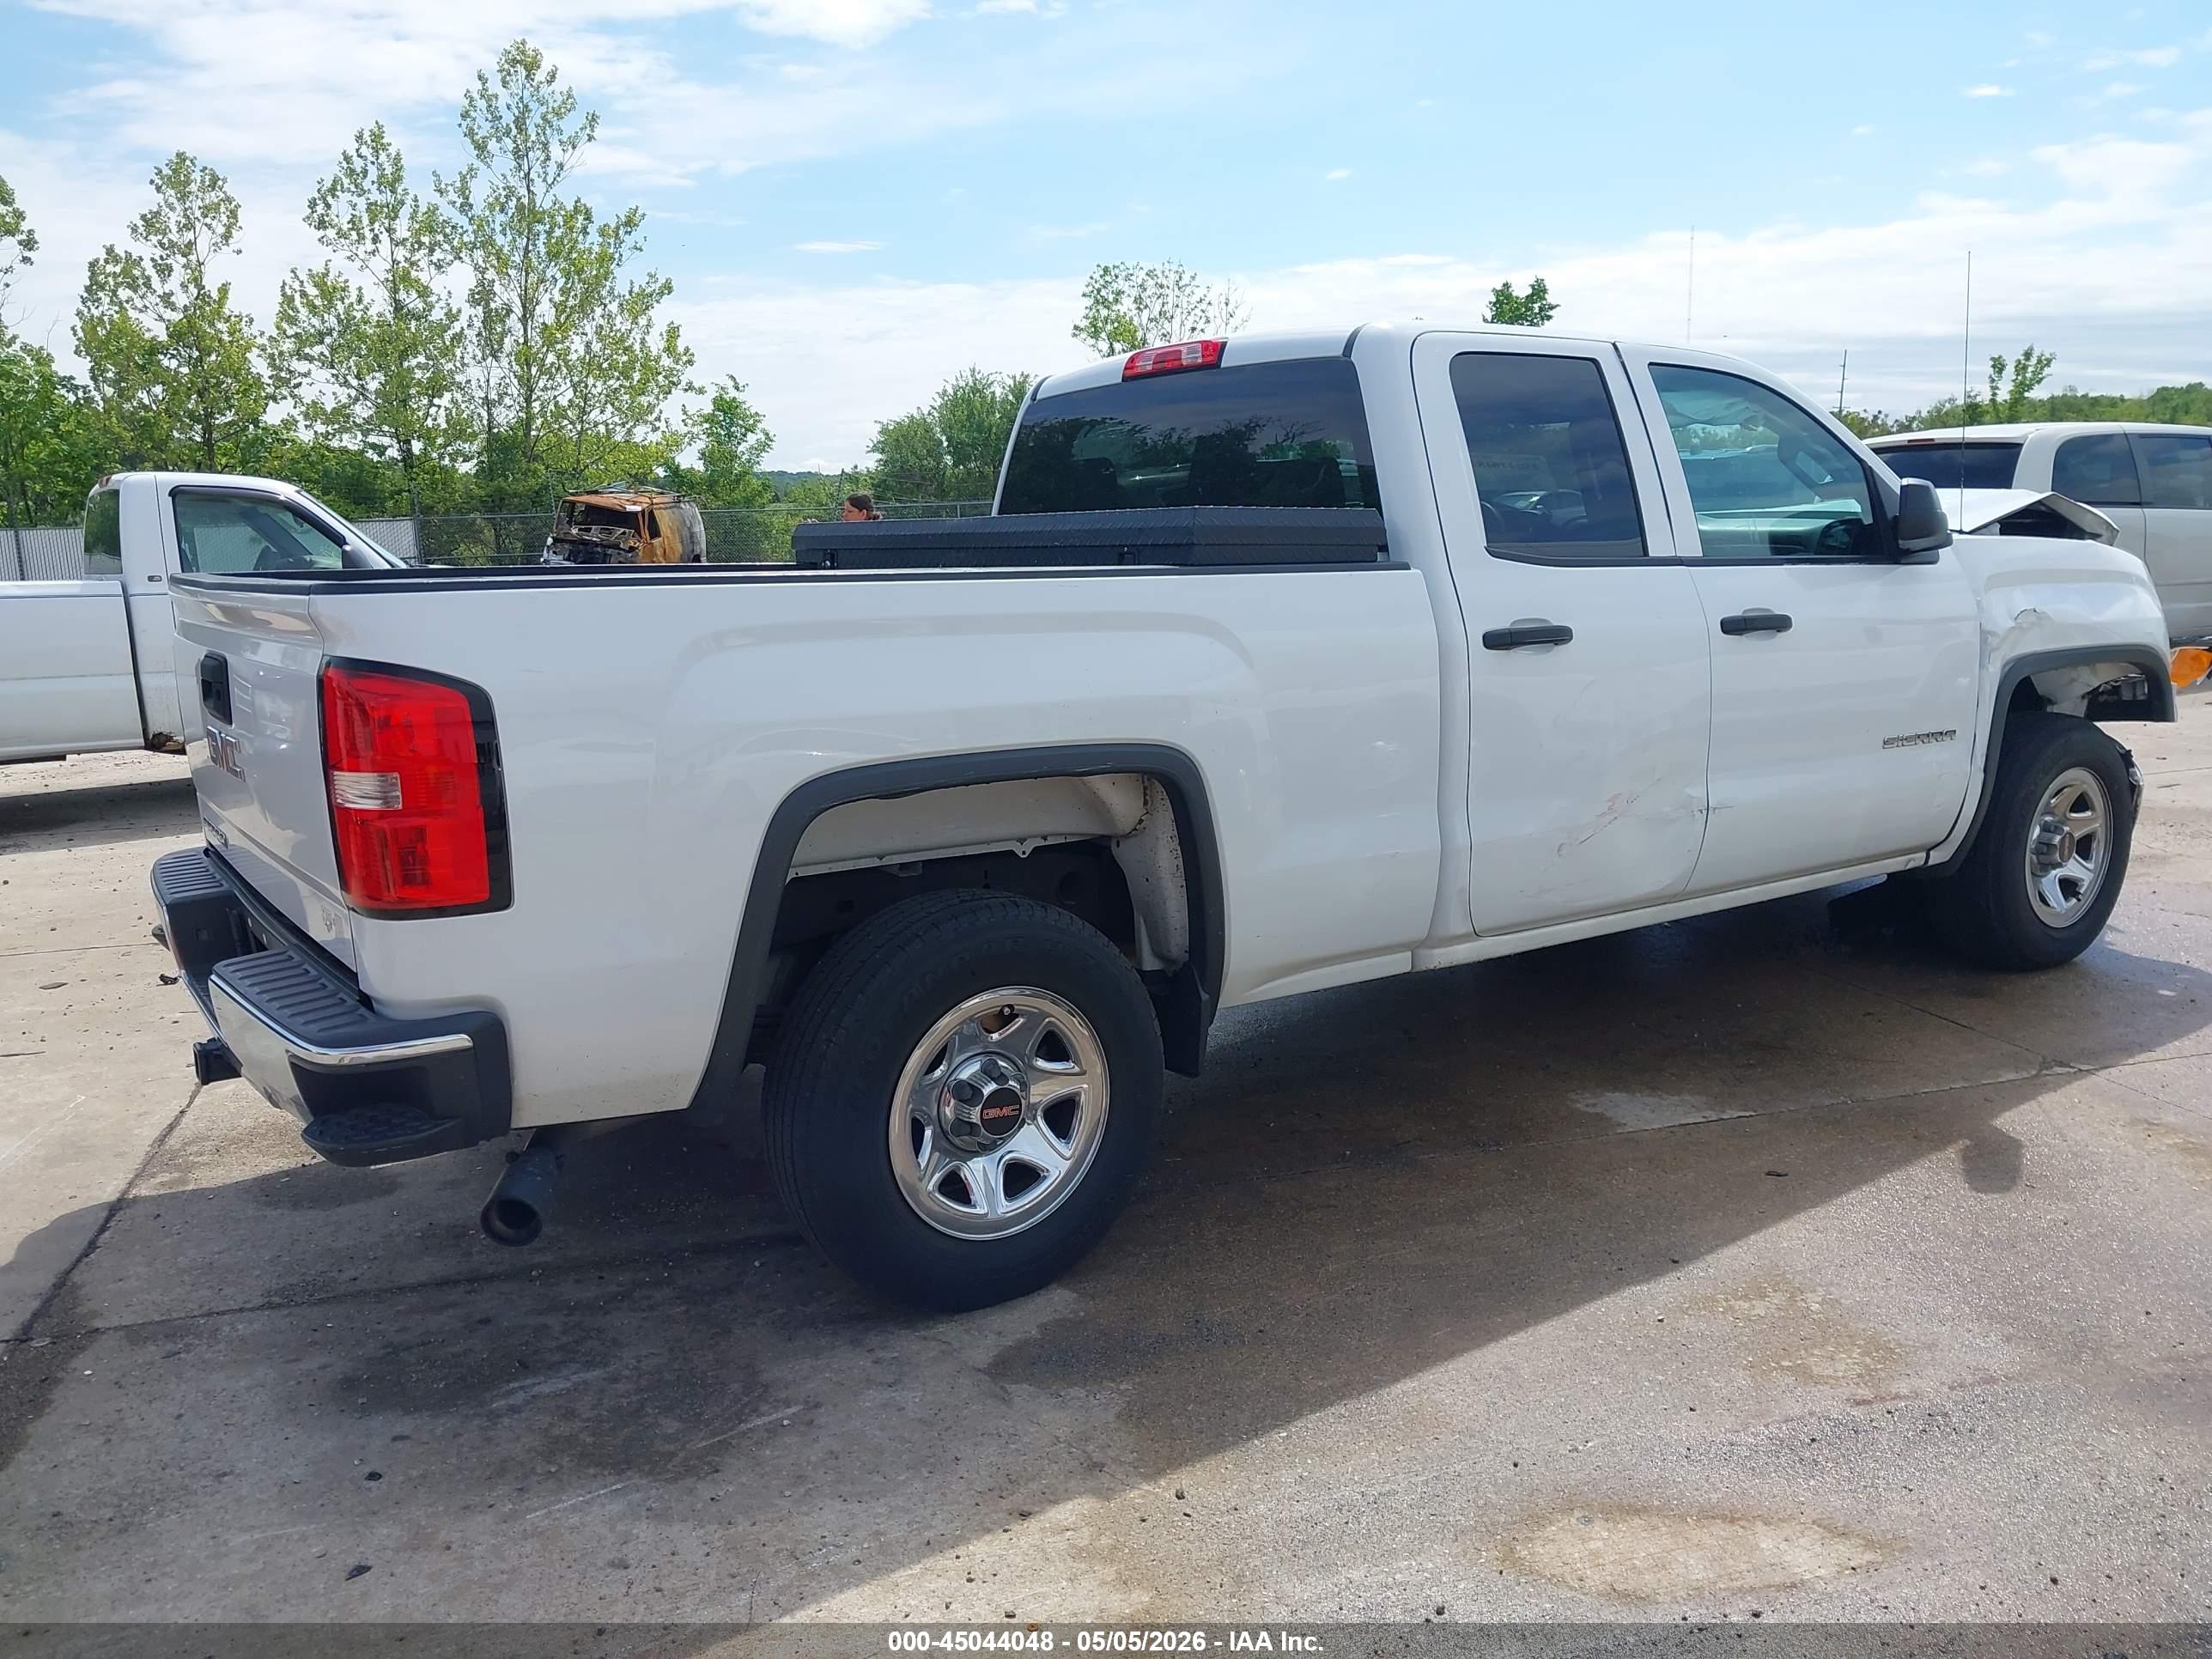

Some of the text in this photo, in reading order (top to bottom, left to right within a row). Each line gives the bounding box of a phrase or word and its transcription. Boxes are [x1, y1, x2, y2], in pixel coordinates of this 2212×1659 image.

[1882, 728, 1957, 749] SIERRA
[207, 726, 246, 782] GMC
[982, 1104, 1019, 1119] GMC
